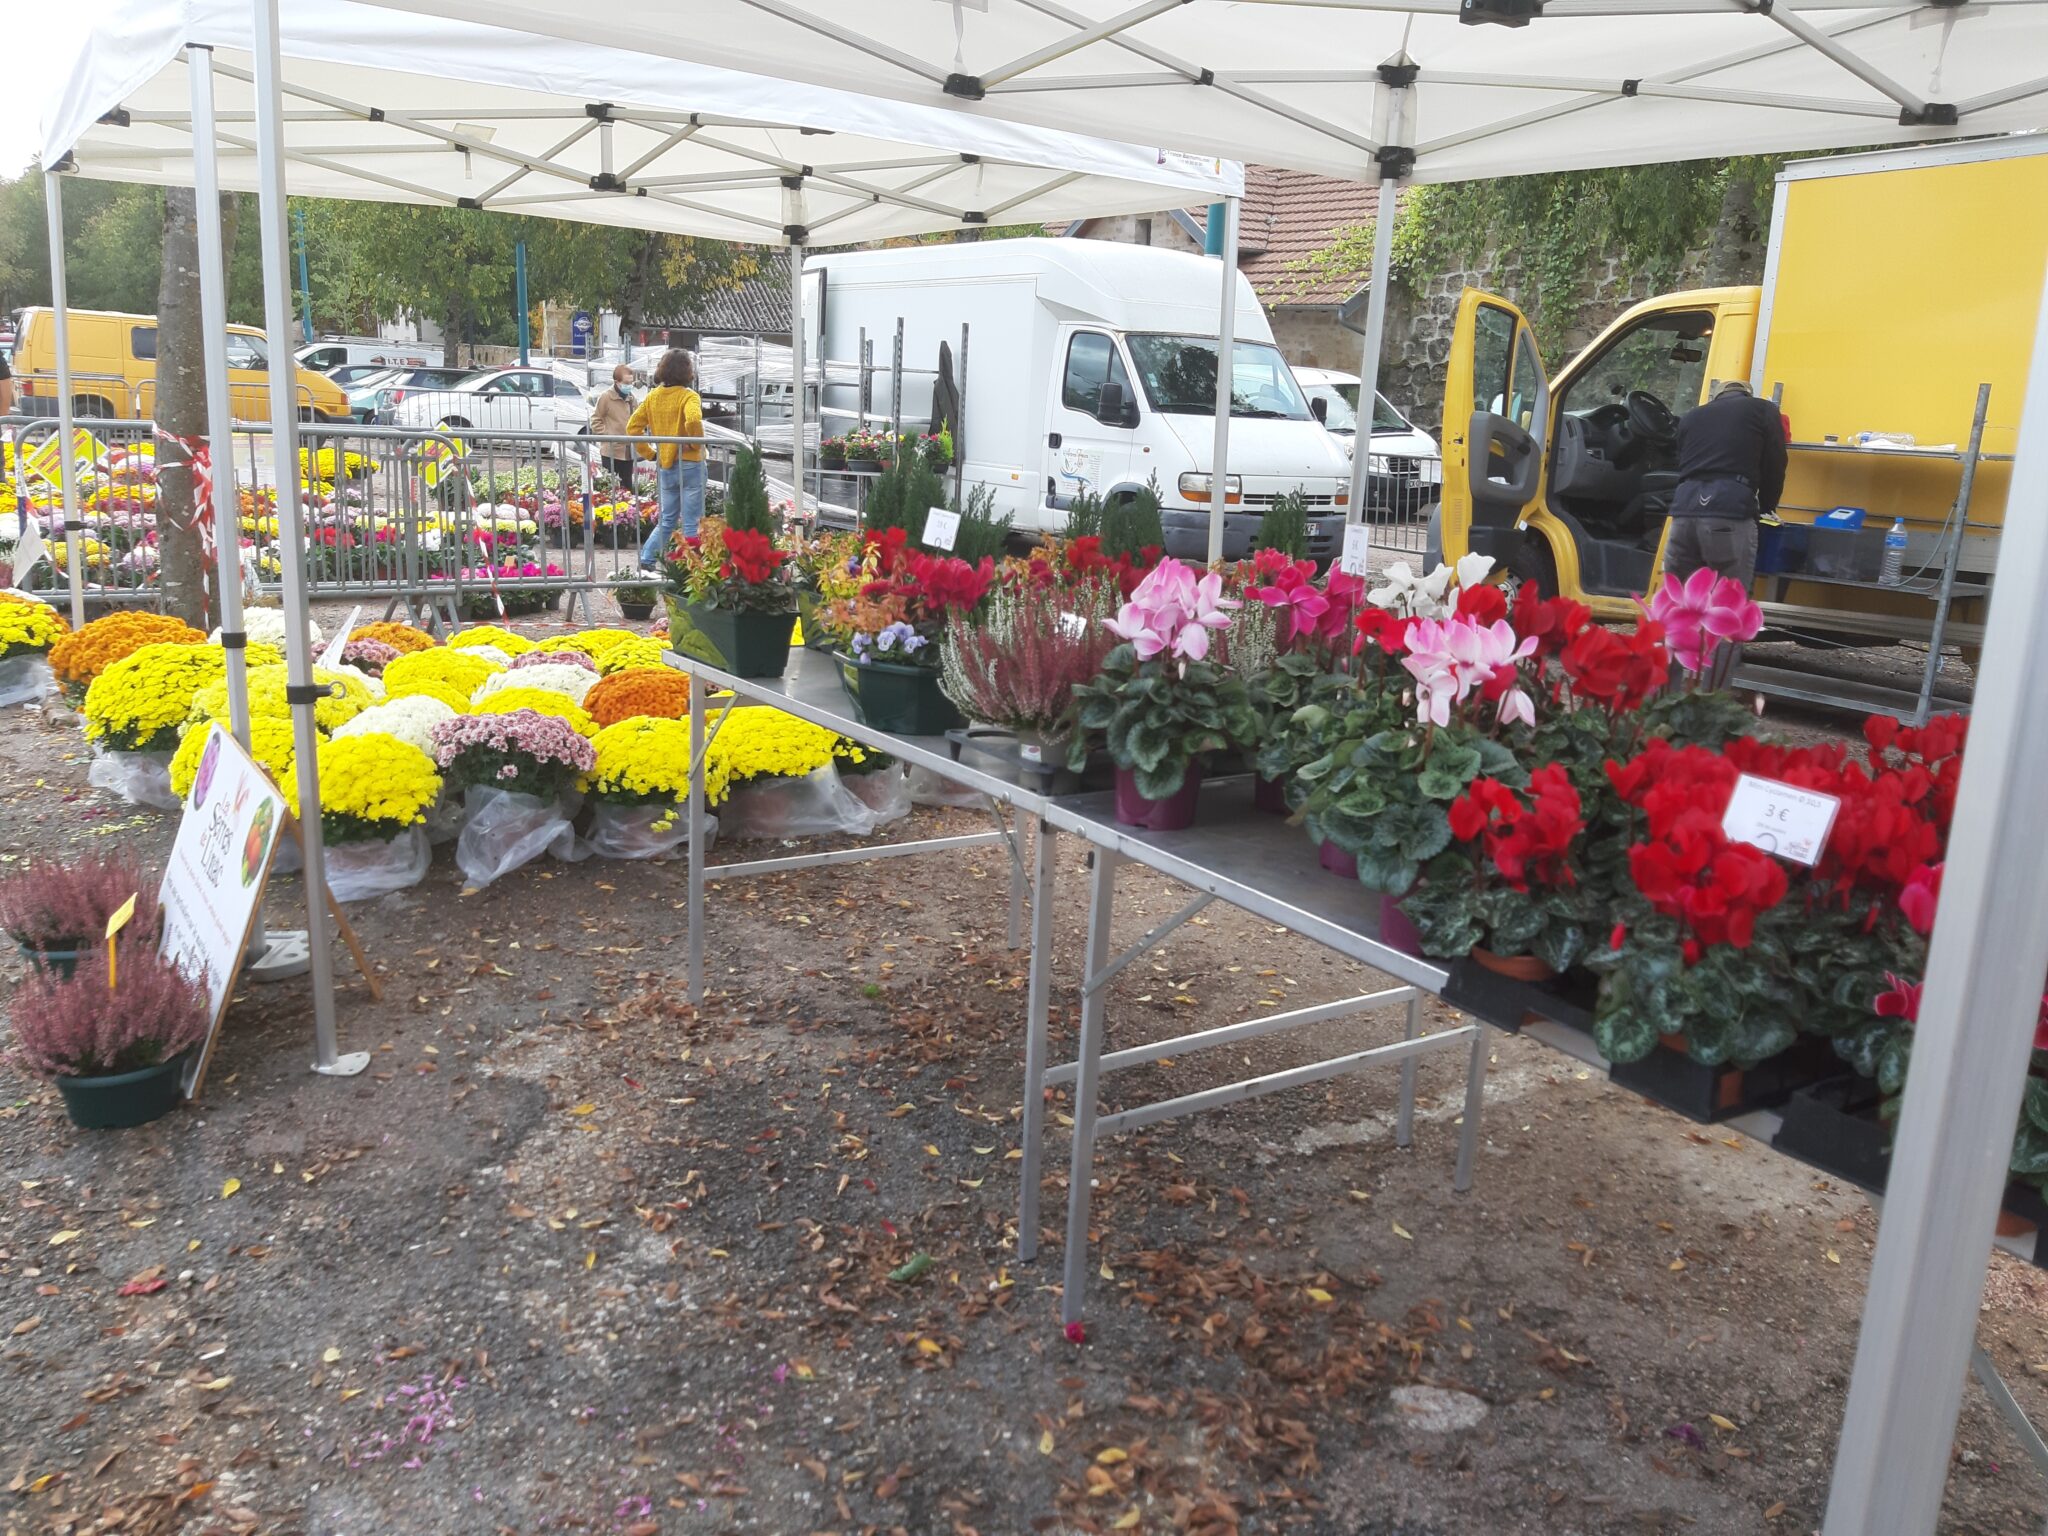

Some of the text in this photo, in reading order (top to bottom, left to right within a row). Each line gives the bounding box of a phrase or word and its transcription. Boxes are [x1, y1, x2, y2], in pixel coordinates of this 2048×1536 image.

[208, 802, 233, 855] Serres
[1764, 804, 1791, 822] 3 €
